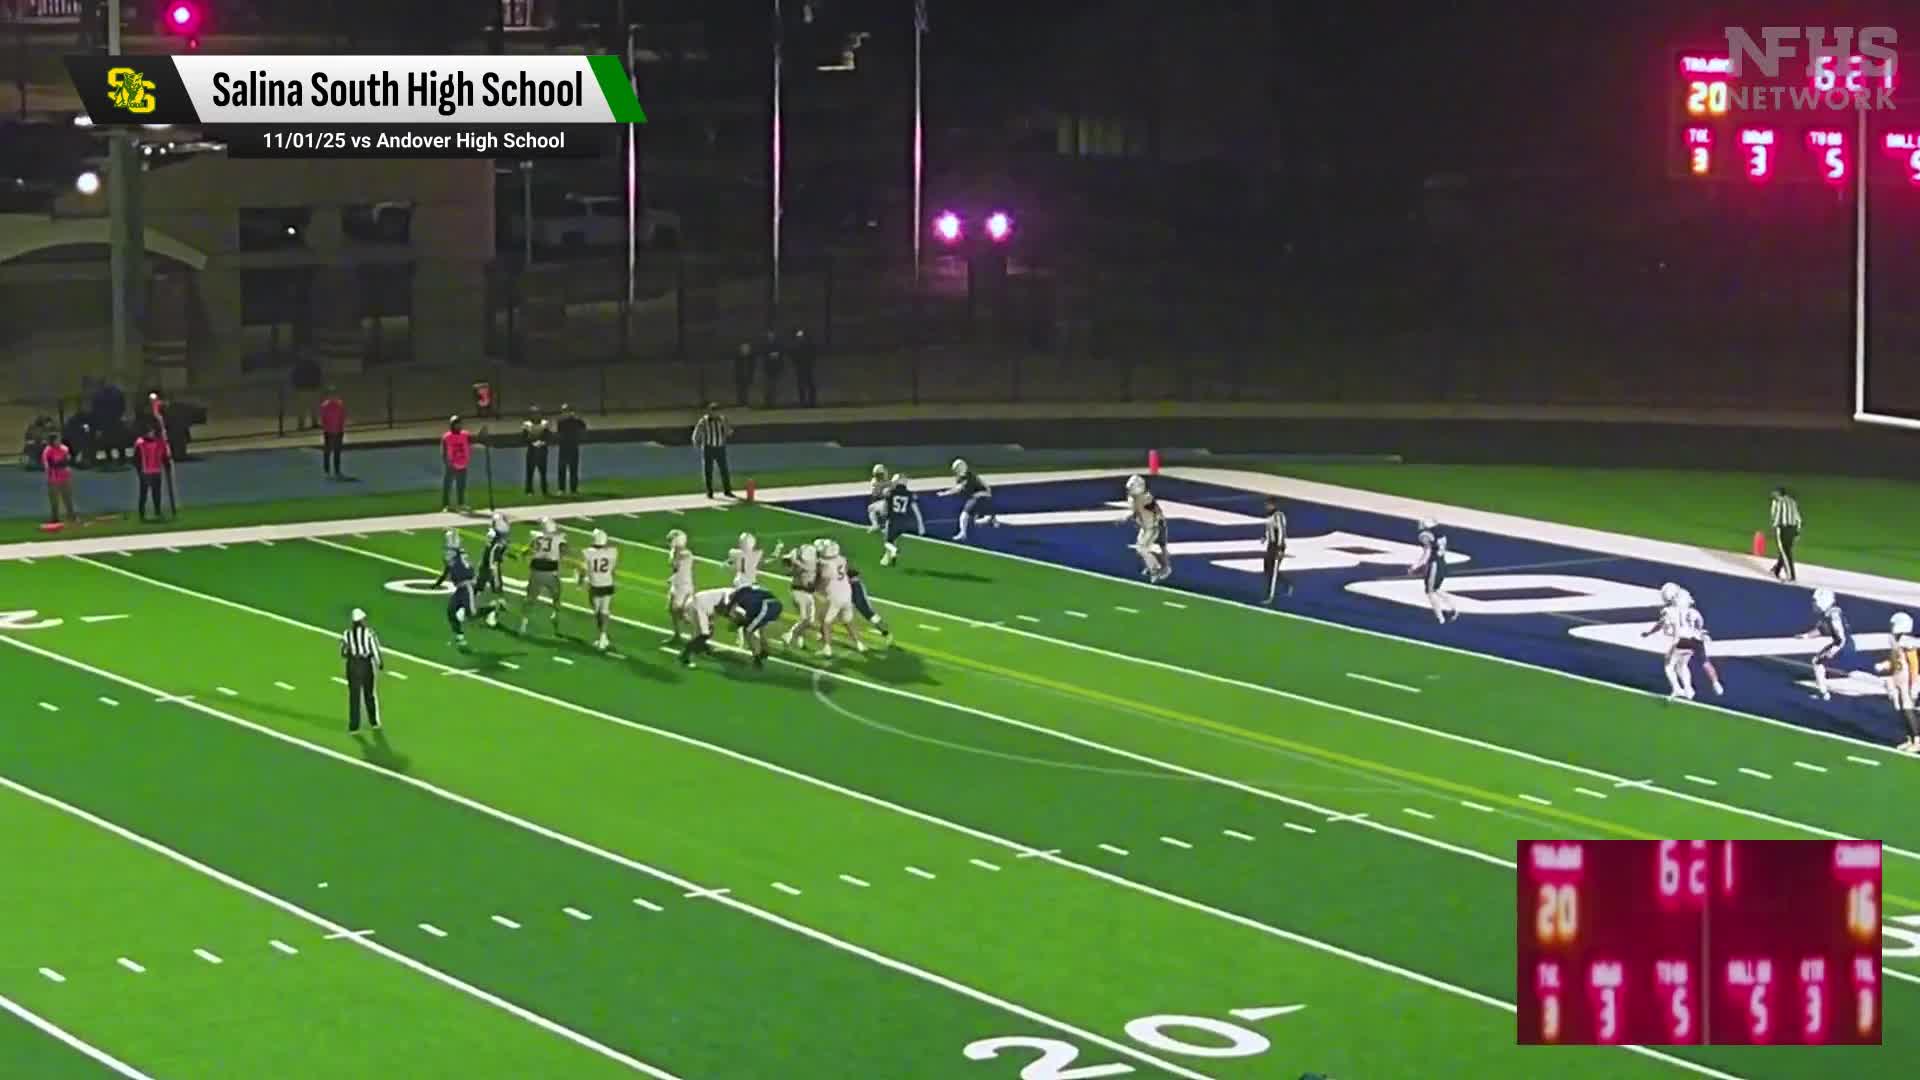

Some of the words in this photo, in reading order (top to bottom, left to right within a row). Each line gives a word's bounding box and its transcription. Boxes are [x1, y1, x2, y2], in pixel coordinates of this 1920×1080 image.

[1687, 81, 1728, 114] 20
[1750, 146, 1767, 177] 3
[1826, 148, 1845, 178] 5
[892, 495, 909, 513] 57
[593, 557, 609, 573] 12
[963, 1014, 1271, 1080] 20
